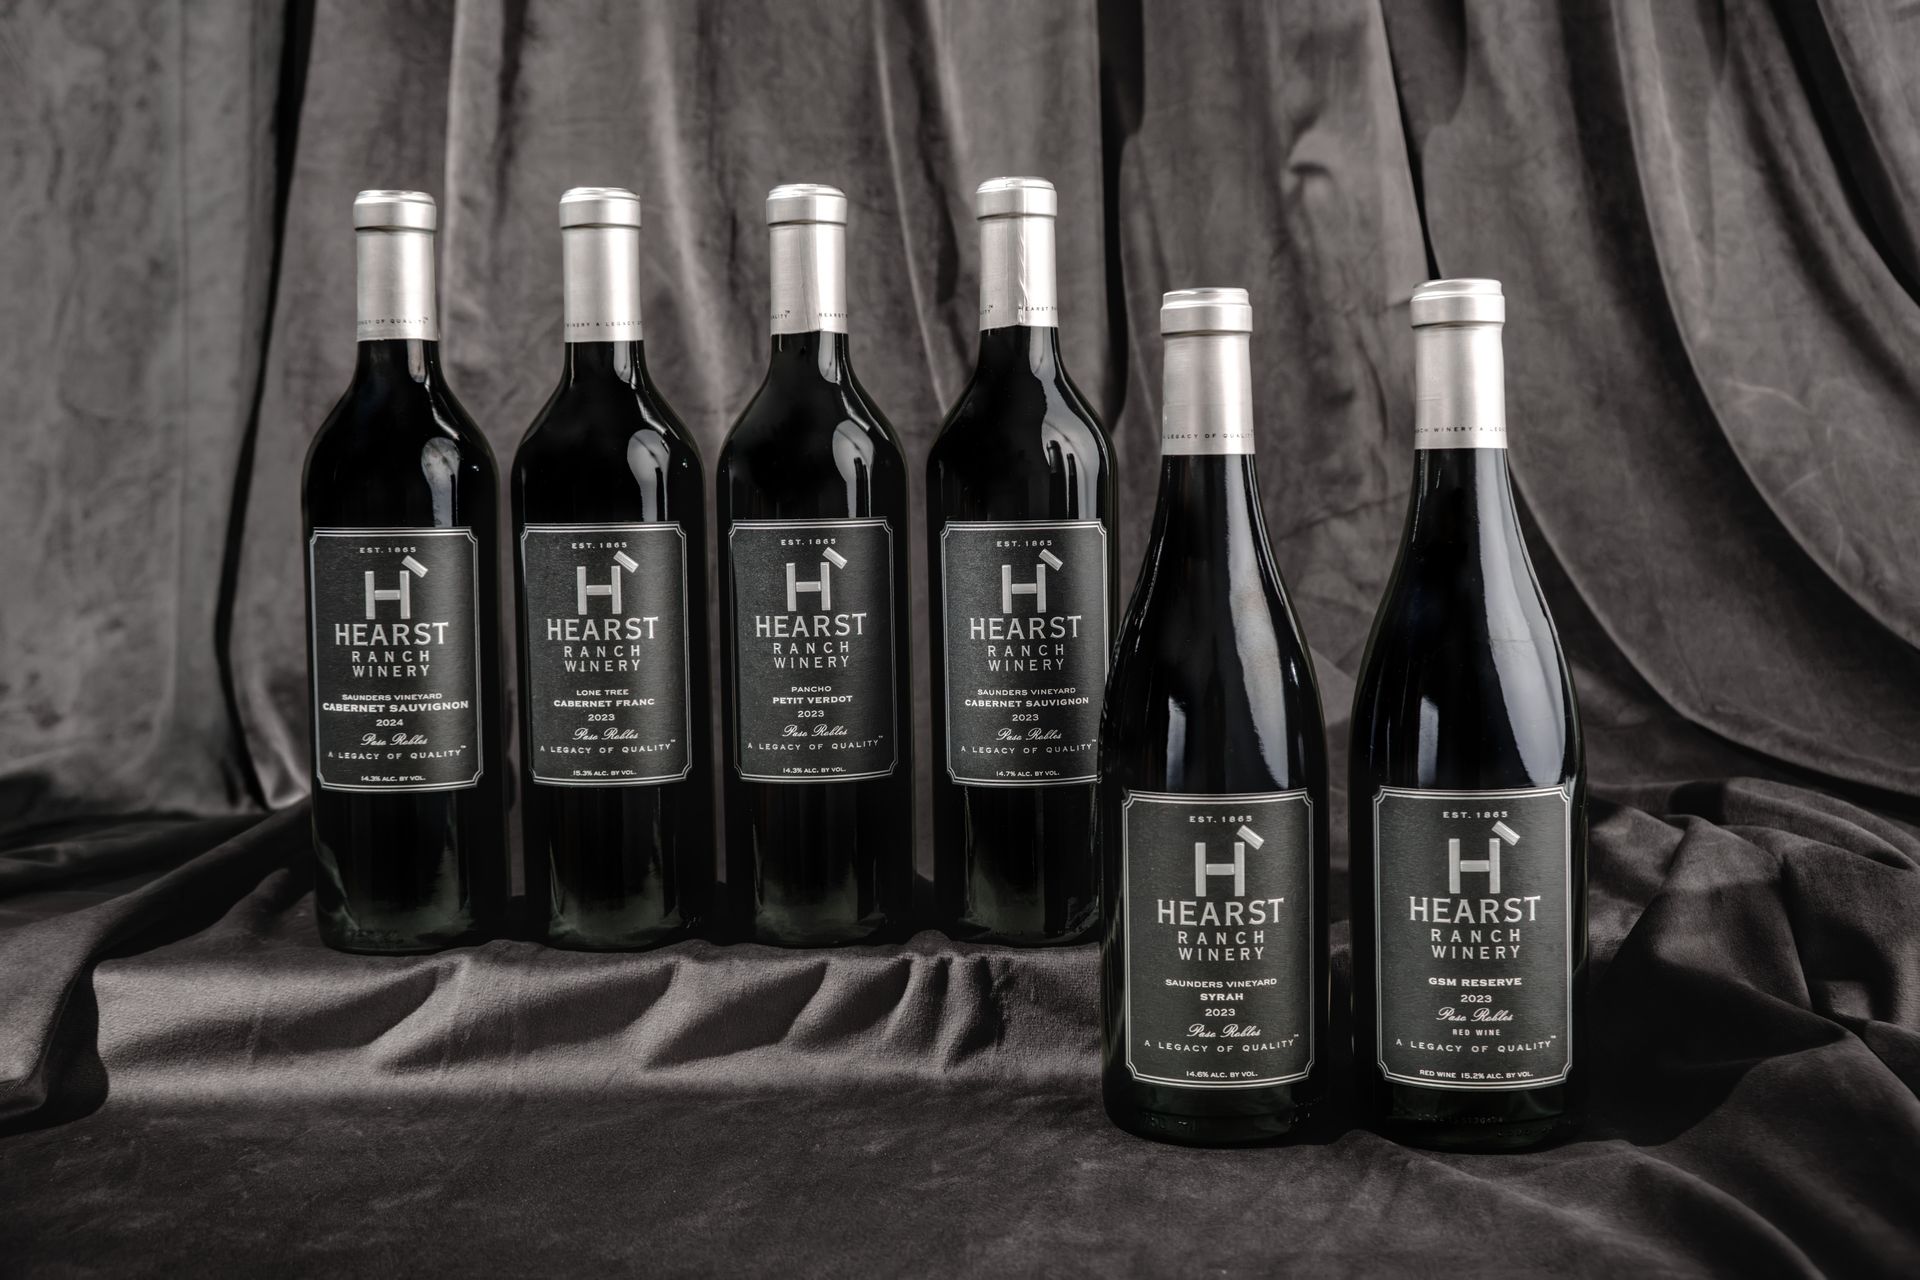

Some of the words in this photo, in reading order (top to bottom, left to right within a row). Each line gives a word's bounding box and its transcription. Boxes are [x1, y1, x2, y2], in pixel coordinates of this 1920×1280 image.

[547, 616, 659, 641] HEARST
[755, 612, 867, 638] HEARST
[970, 615, 1082, 640] HEARST
[335, 622, 449, 646] HEARST
[564, 645, 640, 658] RANCH
[773, 641, 849, 654] RANCH
[988, 644, 1064, 657] RANCH
[351, 650, 430, 663] RANCH
[774, 656, 849, 669] WINERY
[352, 665, 430, 677] WINERY
[564, 659, 641, 673] WINERY
[988, 658, 1064, 672] WINERY
[394, 692, 442, 701] VINEYARD
[1031, 687, 1076, 695] VINEYARD
[553, 700, 613, 708] CABERNET
[616, 698, 655, 707] FRANC
[772, 696, 804, 705] PETIT
[807, 695, 853, 704] VERDOT
[965, 699, 1022, 708] CABERNET
[1026, 696, 1089, 707] SAUVIGNON
[322, 702, 385, 713] CABERNET
[389, 701, 469, 712] SAUVIGNON
[797, 710, 825, 718] 2023
[1012, 714, 1039, 722] 2023
[376, 719, 404, 727] 2024
[572, 728, 599, 741] Paso
[601, 728, 639, 740] Robles
[782, 724, 808, 737] Paso
[811, 724, 848, 737] Robles
[996, 727, 1022, 741] Paso
[1025, 727, 1062, 741] Robles
[360, 733, 387, 746] Paso
[389, 733, 428, 746] Robles
[550, 746, 591, 754] LEGACY
[759, 743, 801, 751] LEGACY
[972, 746, 1015, 754] LEGACY
[338, 752, 380, 760] LEGACY
[1442, 811, 1472, 819] EST.
[1157, 897, 1285, 926] HEARST
[1409, 895, 1541, 924] HEARST
[1178, 931, 1264, 945] RANCH
[1431, 928, 1521, 943] RANCH
[1179, 947, 1265, 961] WINERY
[1432, 945, 1521, 959] WINERY
[1165, 979, 1223, 988] SAUNDERS
[1226, 978, 1277, 987] VINEYARD
[1428, 977, 1457, 986] GSM
[1461, 977, 1522, 987] RESERVE
[1200, 992, 1244, 1001] SYRAH
[1460, 994, 1492, 1003] 2023
[1205, 1008, 1236, 1017] 2023
[1436, 1007, 1467, 1021] Paso
[1470, 1007, 1514, 1021] Robles
[1186, 1023, 1216, 1038] Paso
[1220, 1023, 1262, 1037] Robles
[1159, 1041, 1209, 1053] LEGACY
[1217, 1044, 1234, 1052] OF
[1395, 1038, 1402, 1046] A
[1410, 1040, 1462, 1052] LEGACY
